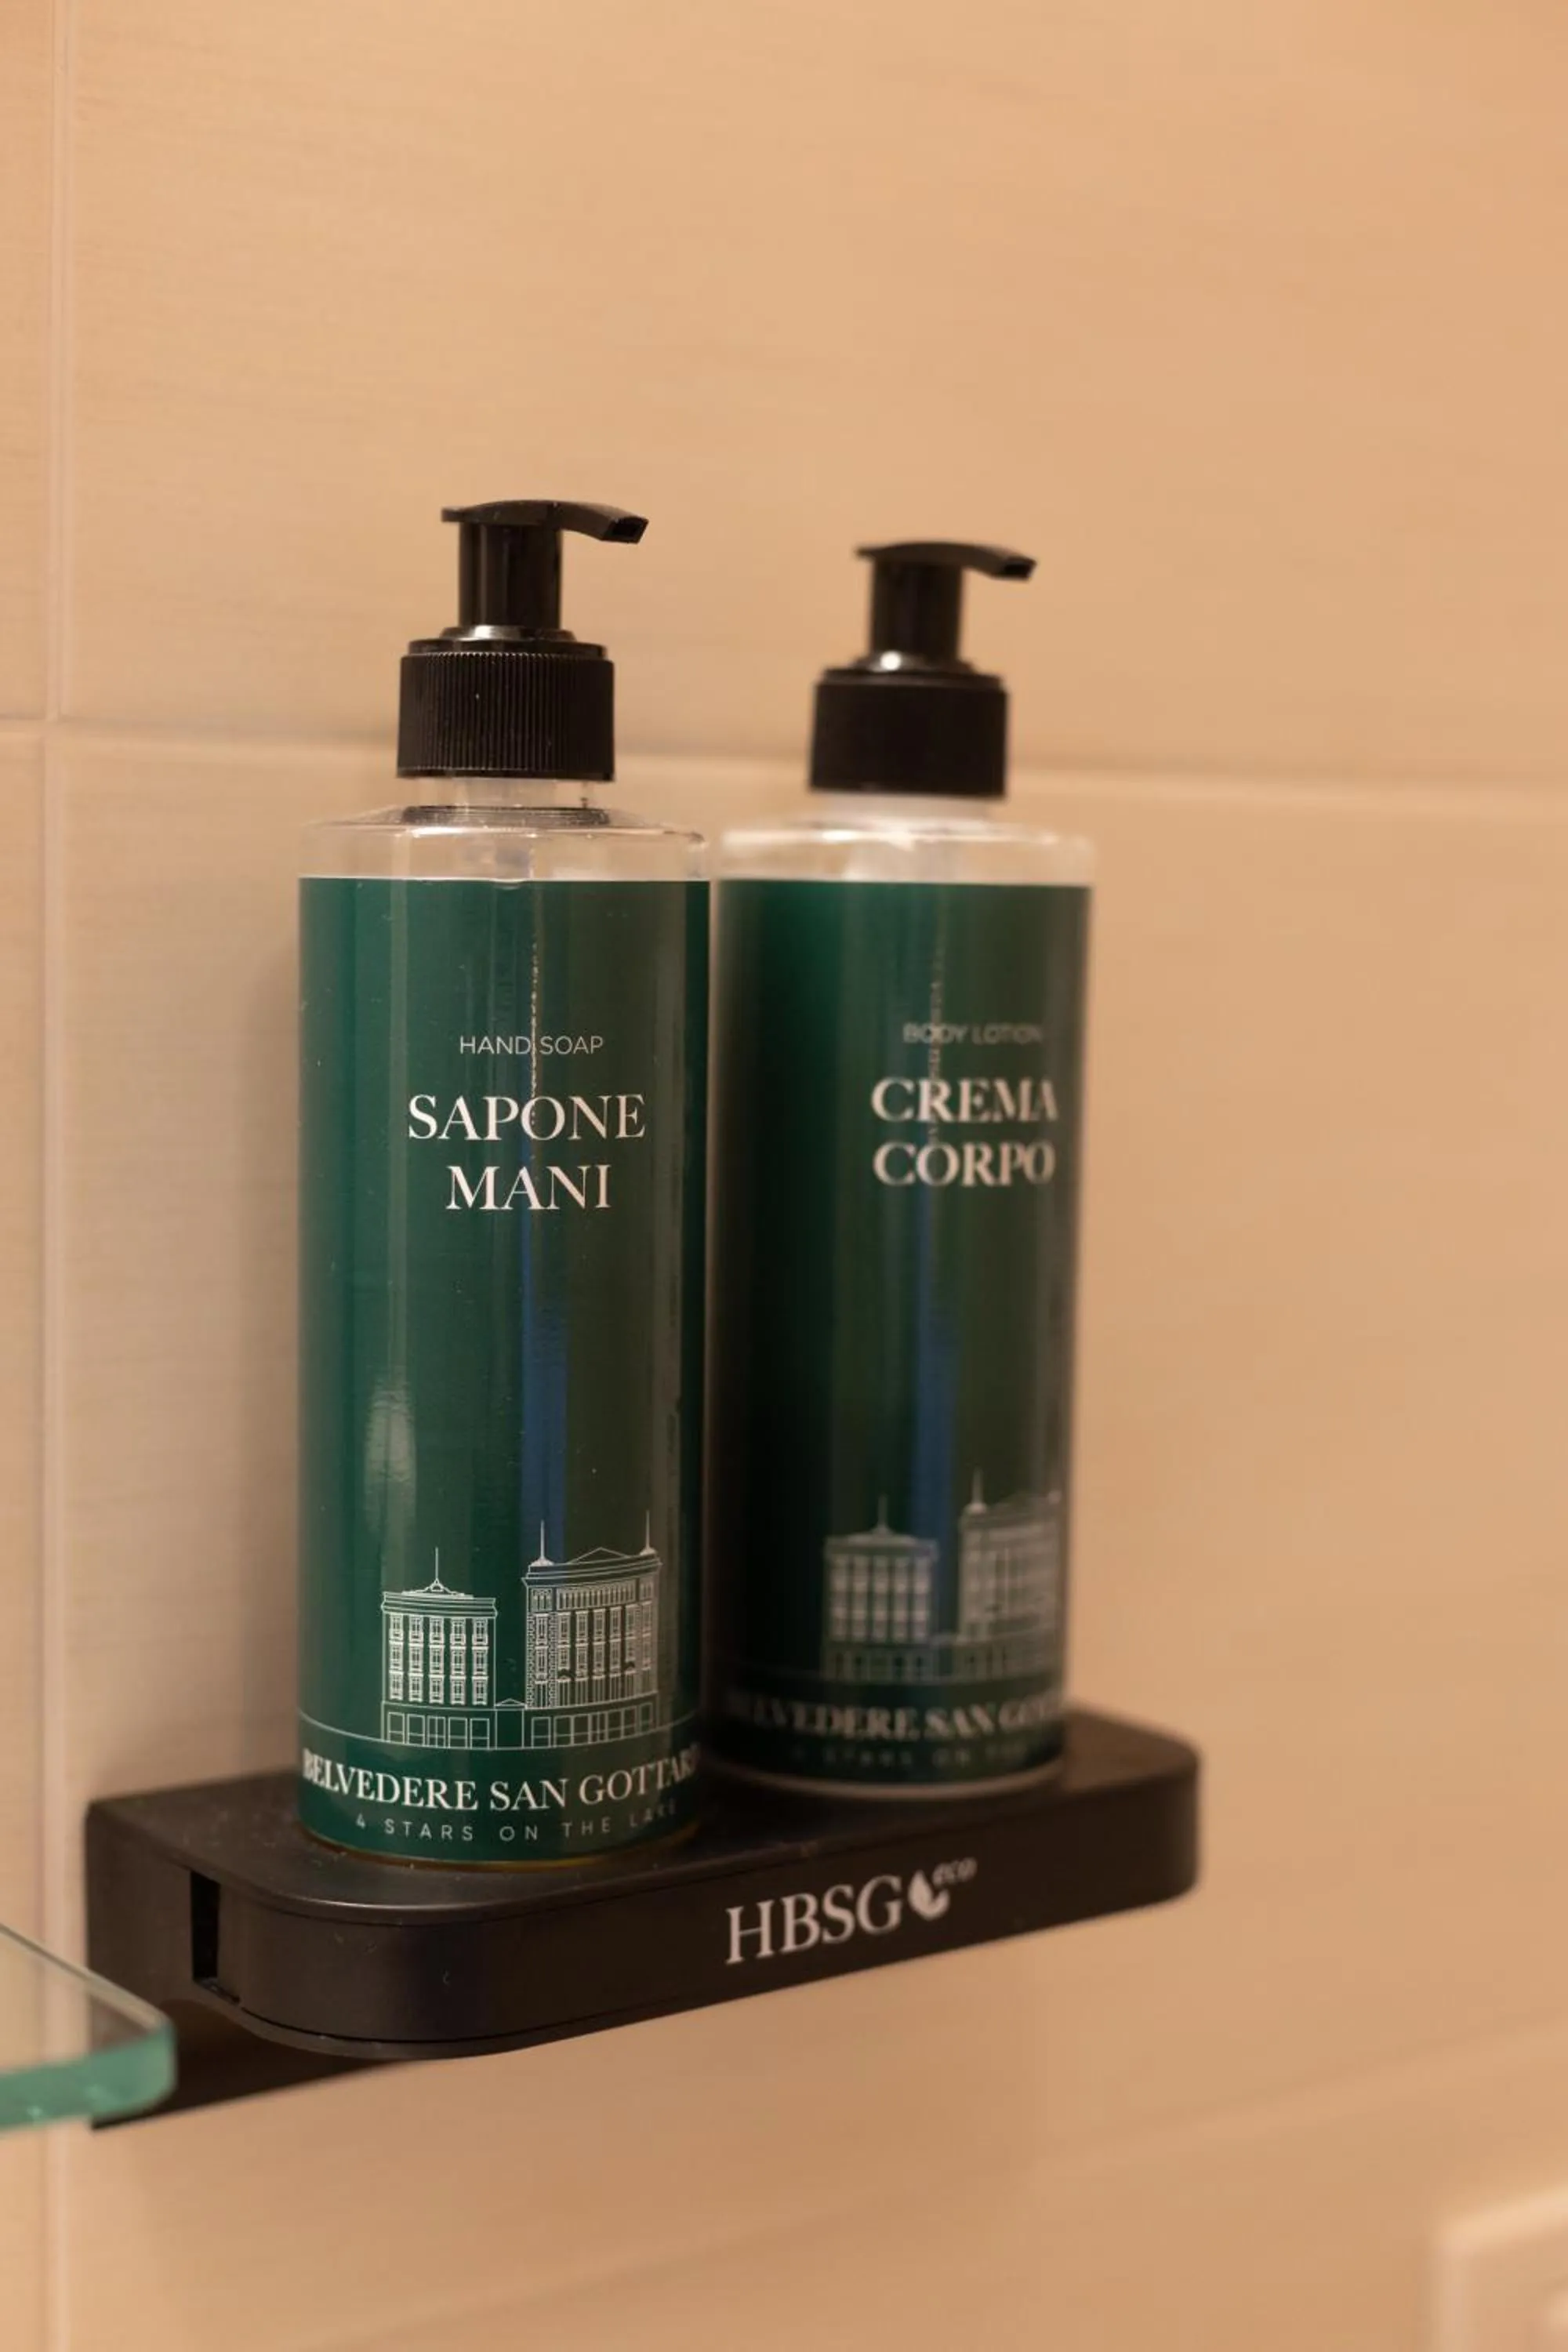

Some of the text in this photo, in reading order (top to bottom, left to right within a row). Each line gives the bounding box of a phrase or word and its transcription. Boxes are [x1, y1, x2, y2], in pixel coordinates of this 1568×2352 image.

[459, 1035, 604, 1055] HAND SOAP
[903, 1022, 968, 1044] BODY
[408, 1094, 646, 1140] SAPONE
[871, 1076, 1058, 1123] CREMA
[446, 1164, 612, 1210] MANI
[873, 1142, 1056, 1187] CORPO
[303, 1748, 480, 1811] BELVEDERE
[490, 1778, 567, 1810] SAN
[356, 1813, 367, 1829] 4
[384, 1817, 474, 1841] STARS
[499, 1826, 539, 1841] ON
[563, 1816, 612, 1838] THE
[725, 1857, 978, 1965] HBSG eco
